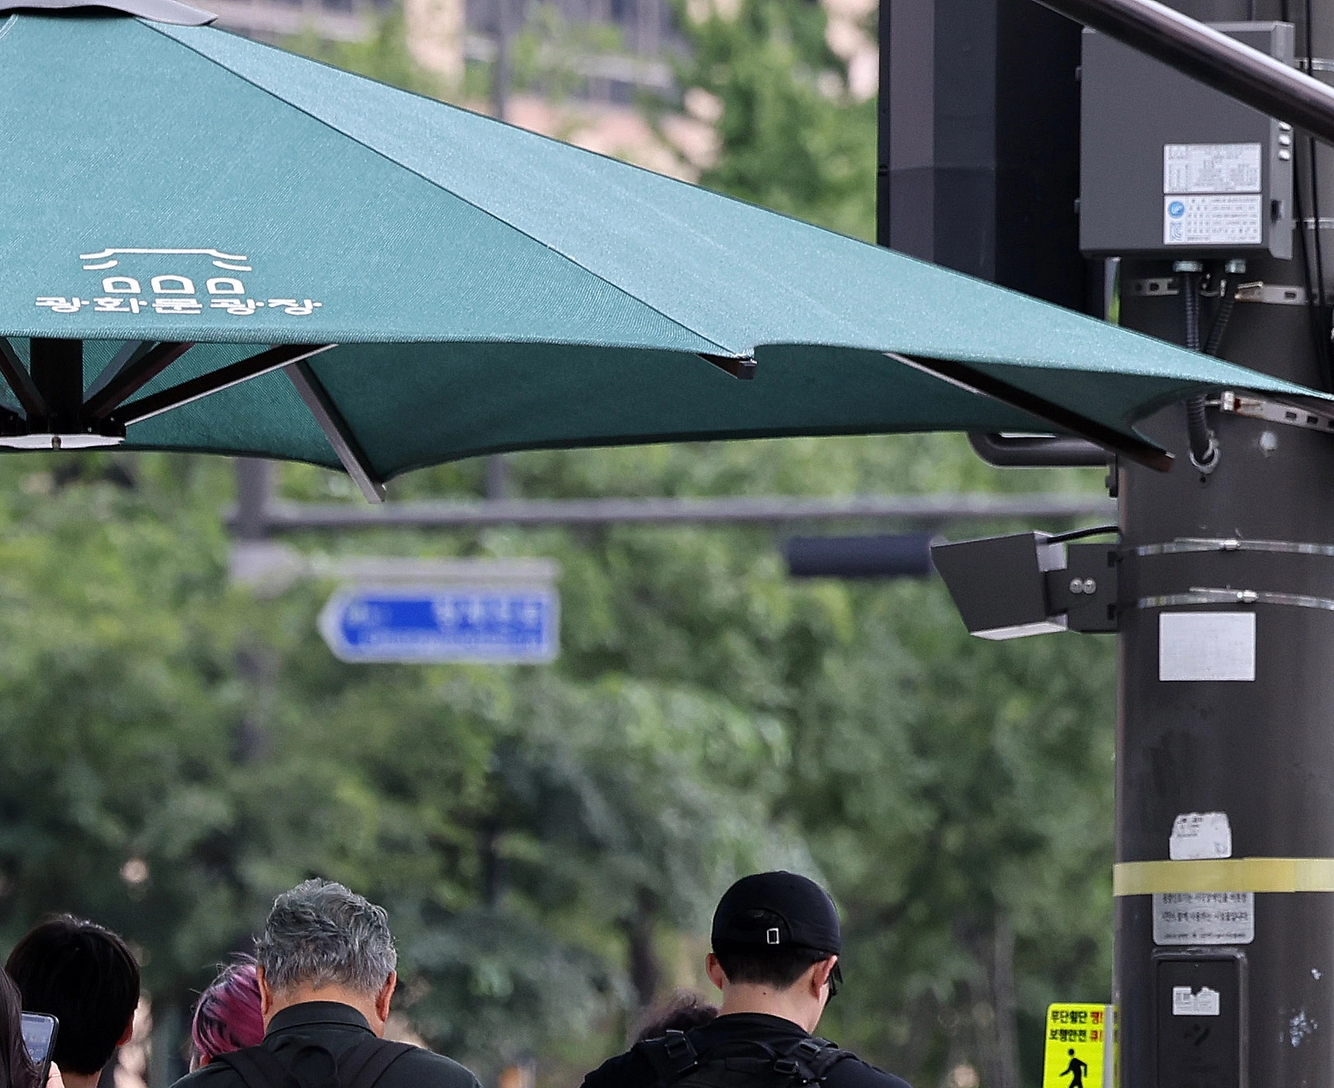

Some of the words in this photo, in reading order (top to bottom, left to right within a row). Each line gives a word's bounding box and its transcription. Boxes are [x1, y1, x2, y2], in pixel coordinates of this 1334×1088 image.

[35, 296, 323, 316] 광화문광장
[1051, 1010, 1088, 1024] 무단횡단
[1049, 1029, 1087, 1042] 보행안전
